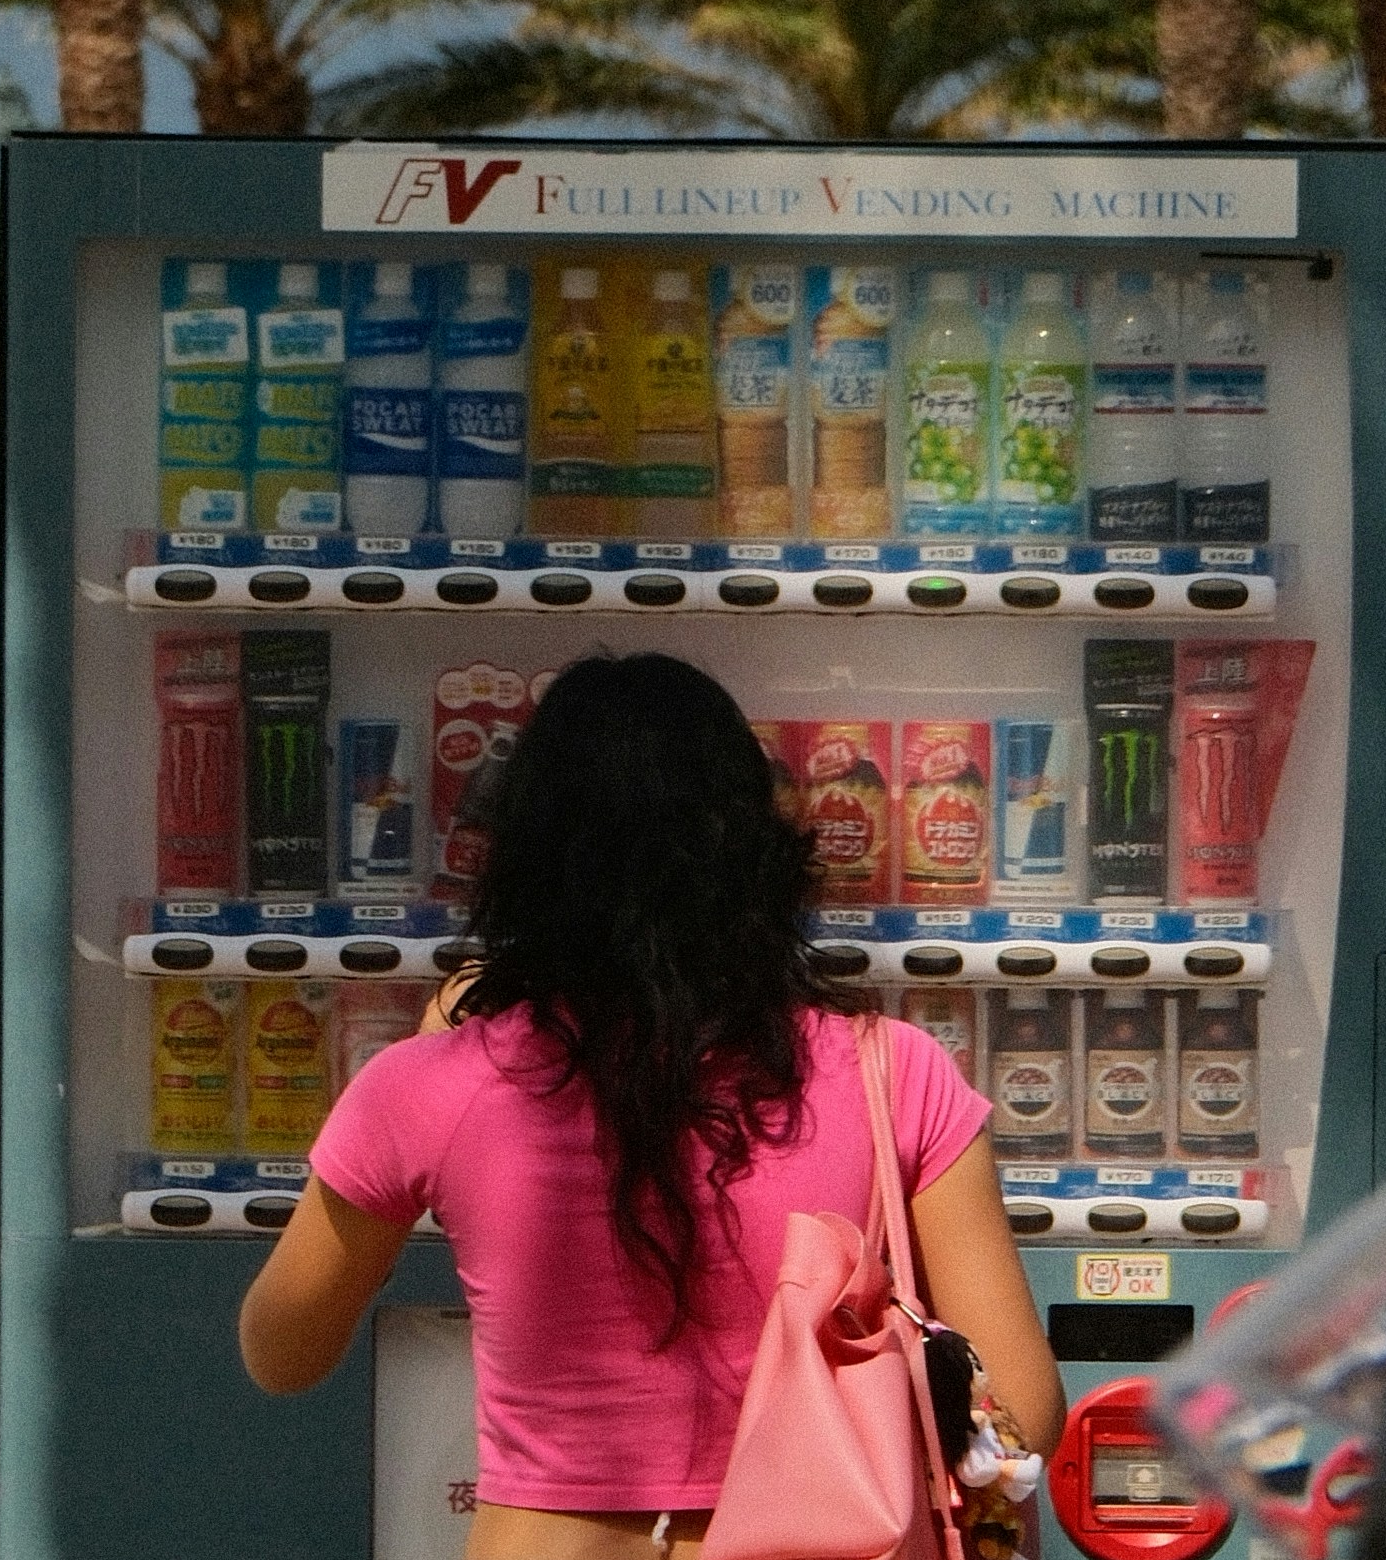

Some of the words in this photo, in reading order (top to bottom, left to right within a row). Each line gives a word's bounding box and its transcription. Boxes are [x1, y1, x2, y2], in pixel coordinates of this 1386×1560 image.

[376, 159, 522, 224] FV
[818, 176, 1012, 218] VENDING
[1052, 190, 1239, 219] MACHINE
[752, 284, 790, 303] 600
[855, 286, 891, 305] 600
[352, 417, 424, 433] SWEAT
[448, 418, 517, 435] SWEAT
[173, 904, 212, 915] ¥230
[359, 907, 399, 918] ¥230
[1129, 1279, 1155, 1293] OK
